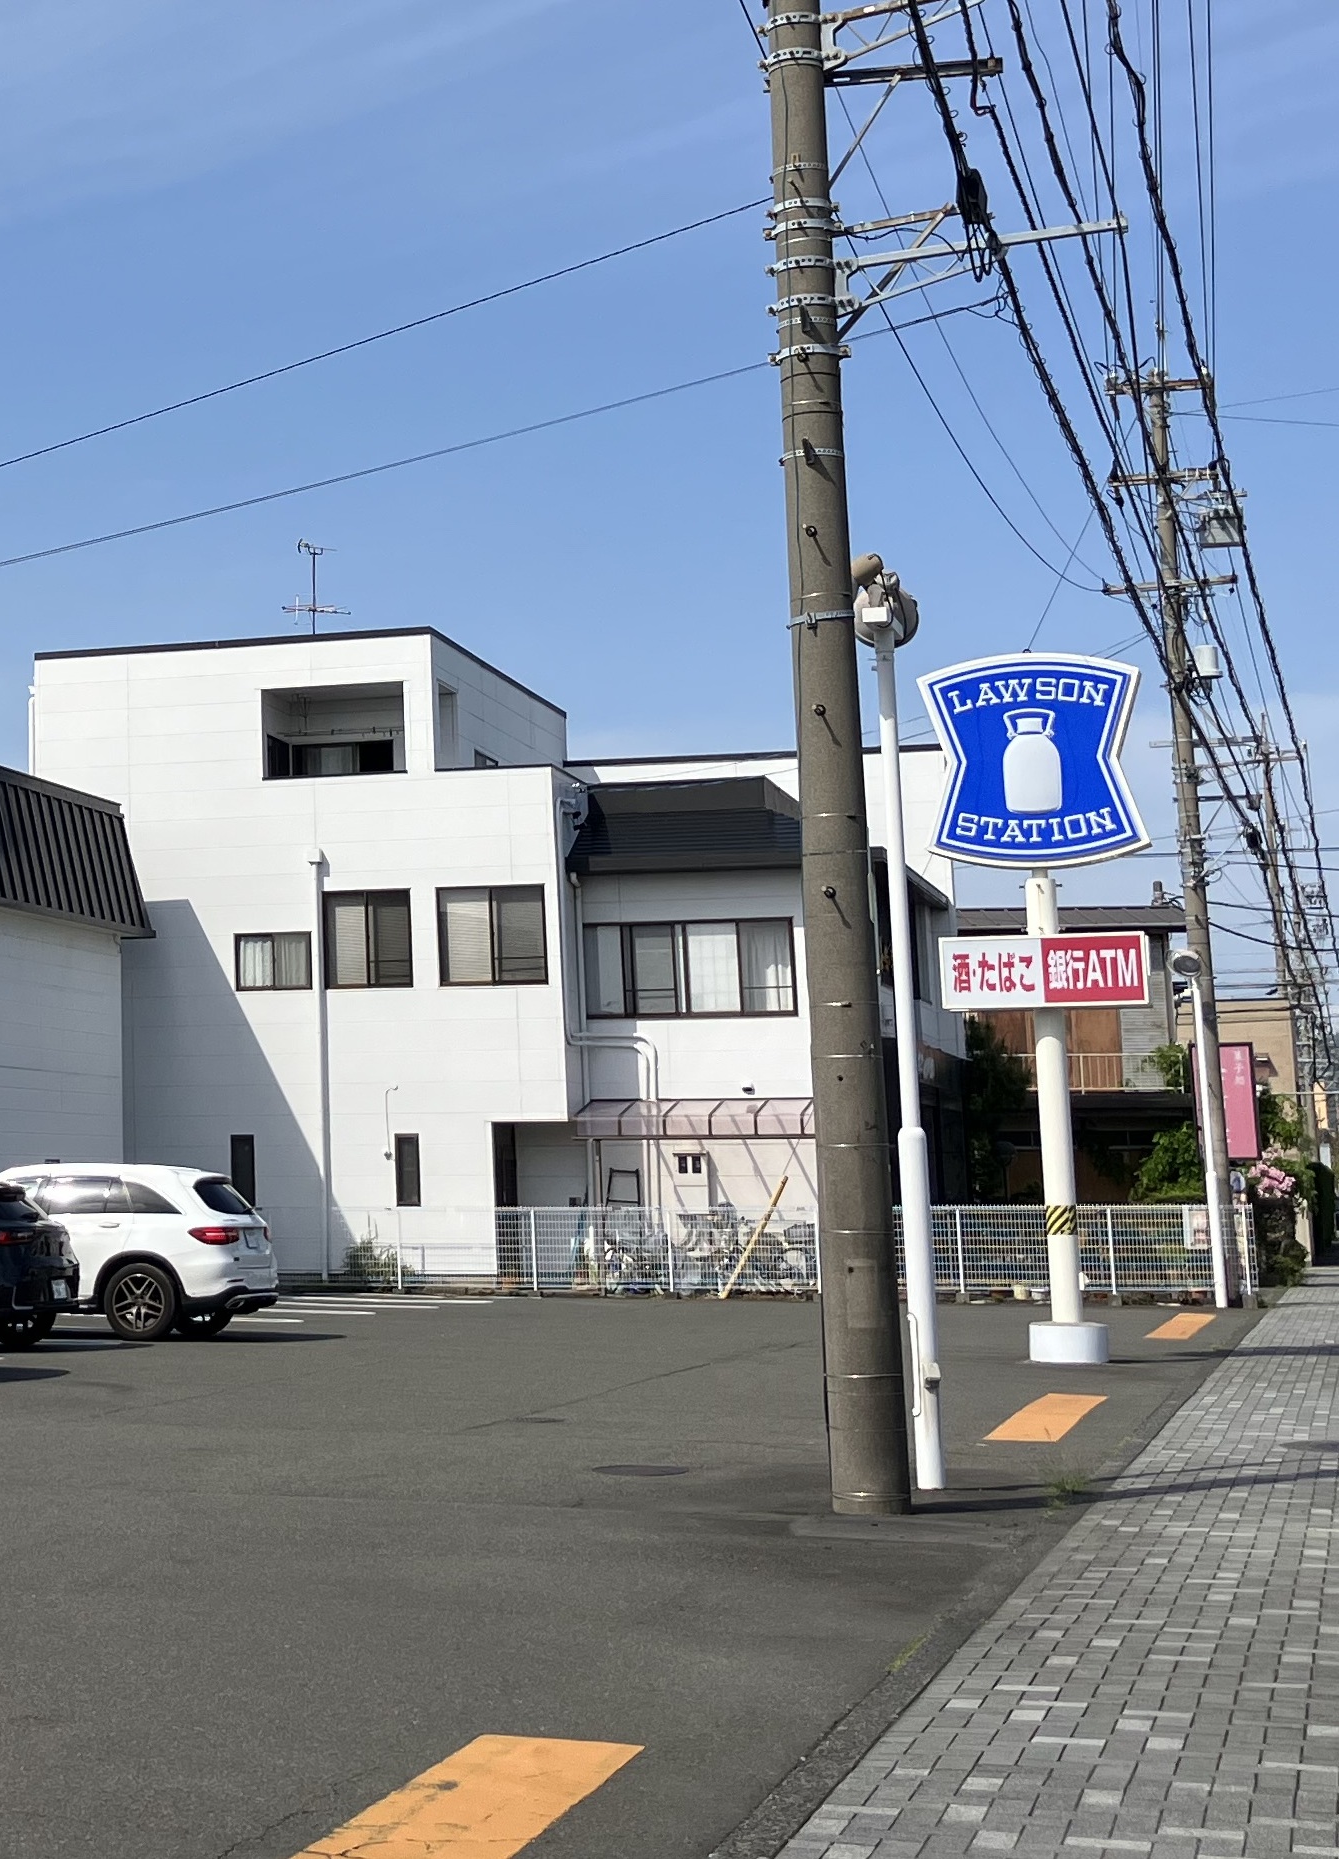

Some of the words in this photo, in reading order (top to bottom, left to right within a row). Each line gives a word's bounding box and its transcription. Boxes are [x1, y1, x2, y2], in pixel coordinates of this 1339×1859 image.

[948, 677, 1109, 714] LAWSON
[956, 807, 1117, 843] STATION
[1047, 948, 1140, 989] 銀行ATM
